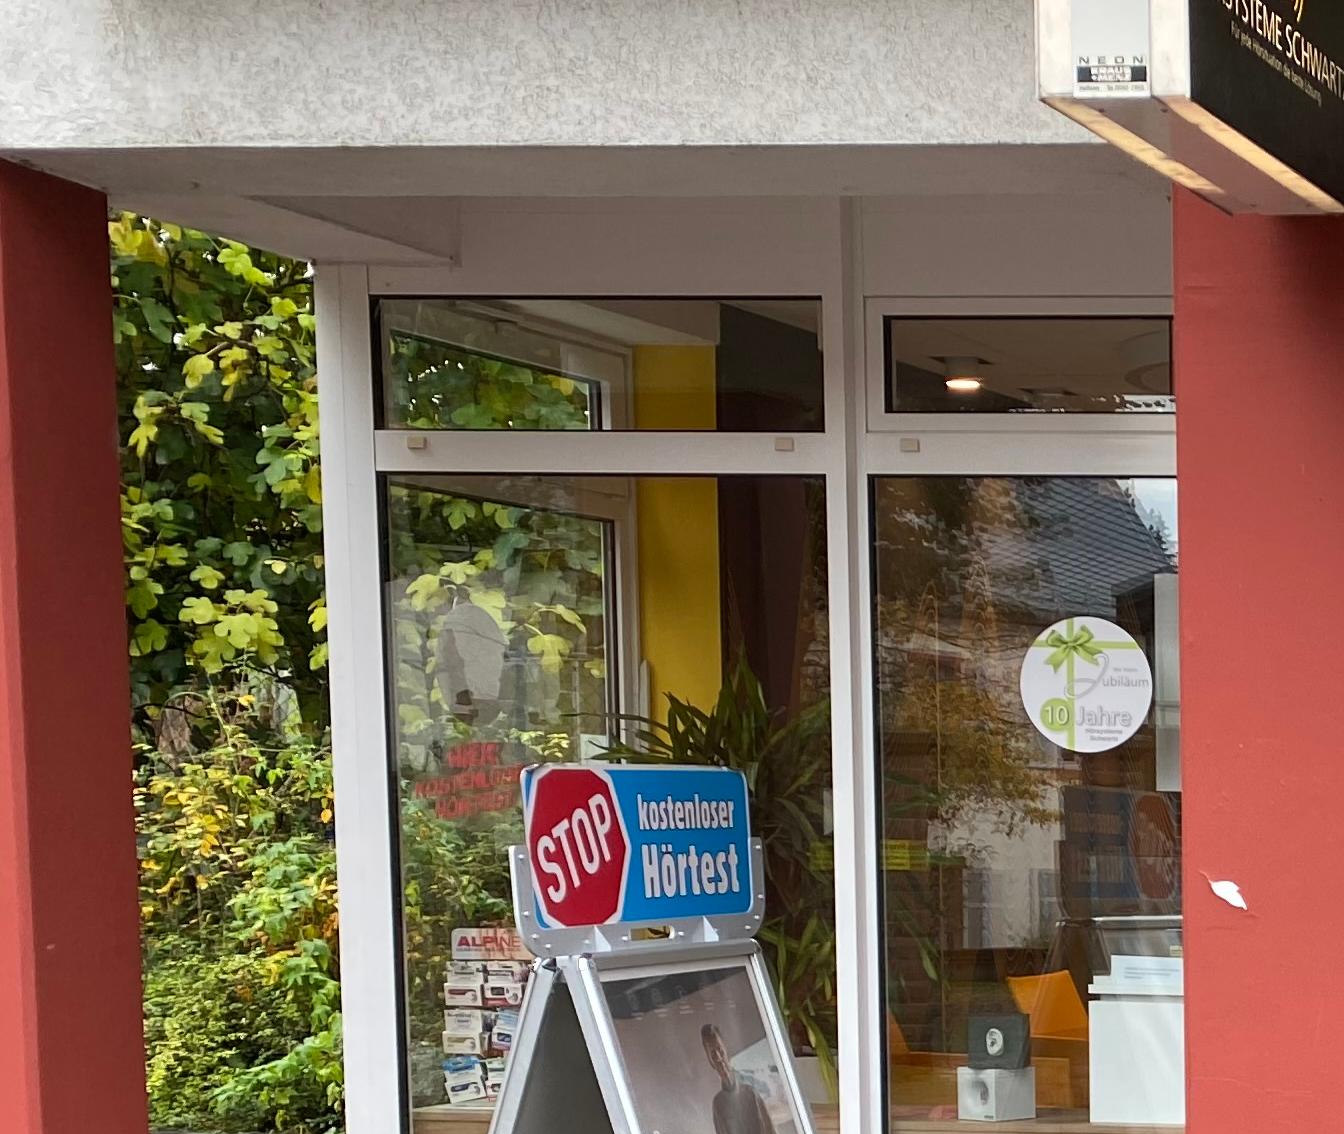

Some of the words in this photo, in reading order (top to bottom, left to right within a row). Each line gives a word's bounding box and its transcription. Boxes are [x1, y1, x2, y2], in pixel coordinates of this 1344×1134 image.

[1222, 0, 1283, 51] YSTEME
[1078, 55, 1144, 64] NEON
[1044, 705, 1070, 725] 10
[1075, 705, 1133, 728] Jahre
[636, 793, 735, 830] kostenloser
[536, 793, 612, 903] STOP
[641, 843, 740, 899] Hörtest
[457, 935, 521, 948] ALPINE
